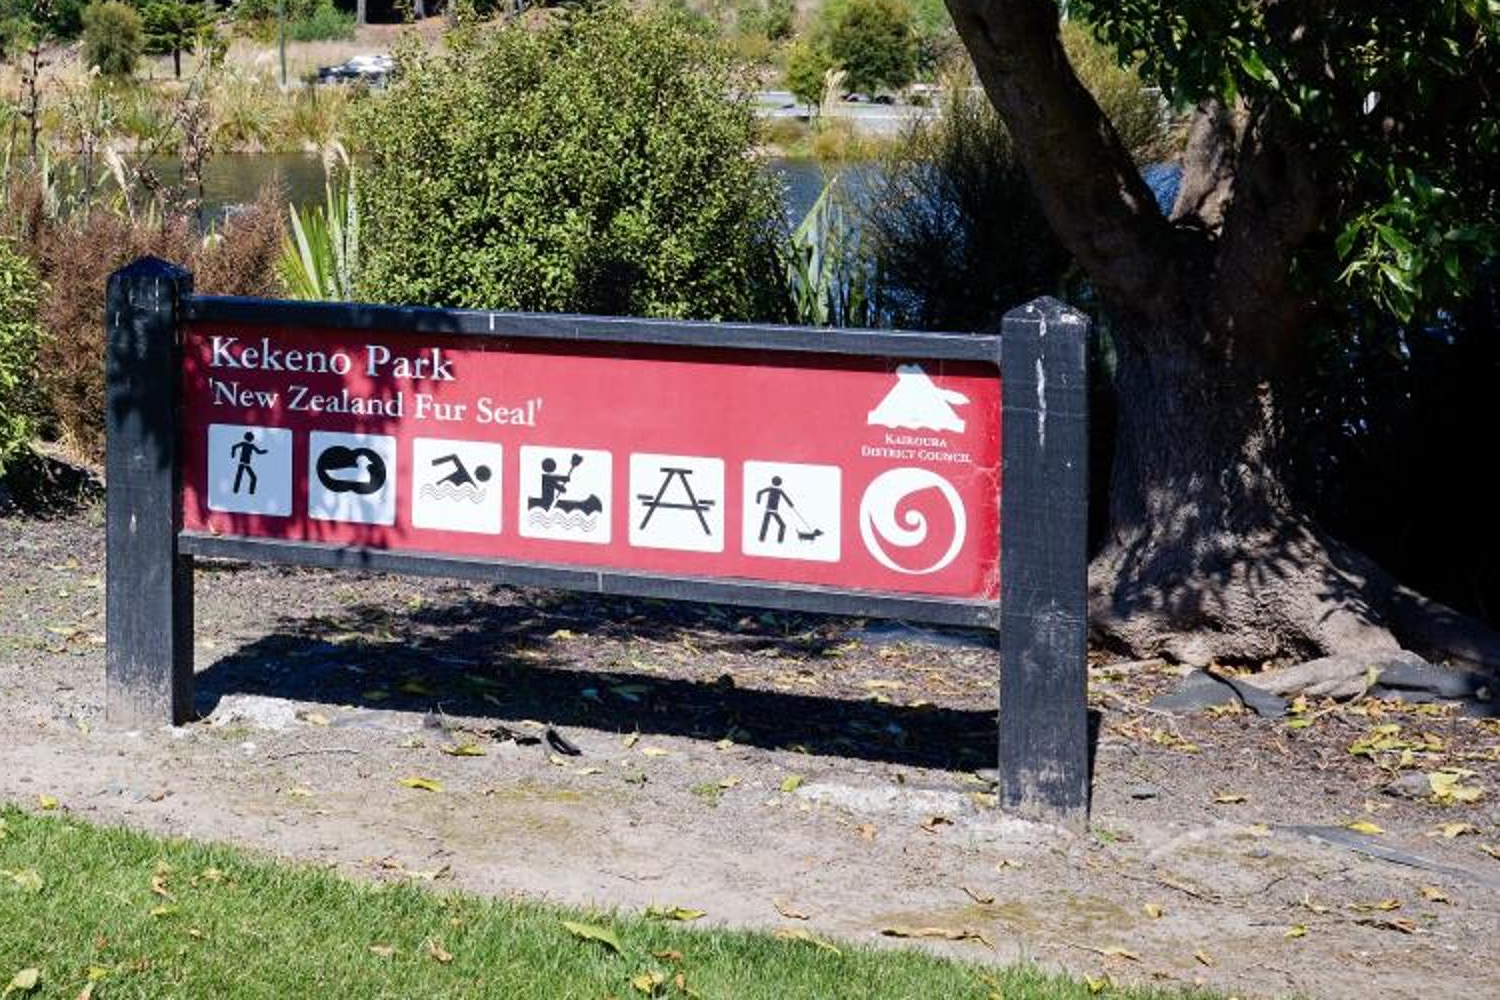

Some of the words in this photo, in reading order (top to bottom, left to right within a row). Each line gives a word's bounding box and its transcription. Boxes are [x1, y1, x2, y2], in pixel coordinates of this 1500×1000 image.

[210, 335, 352, 376] Kekeno
[364, 344, 456, 381] Park
[287, 384, 403, 418] Zealand
[414, 392, 467, 421] Fur
